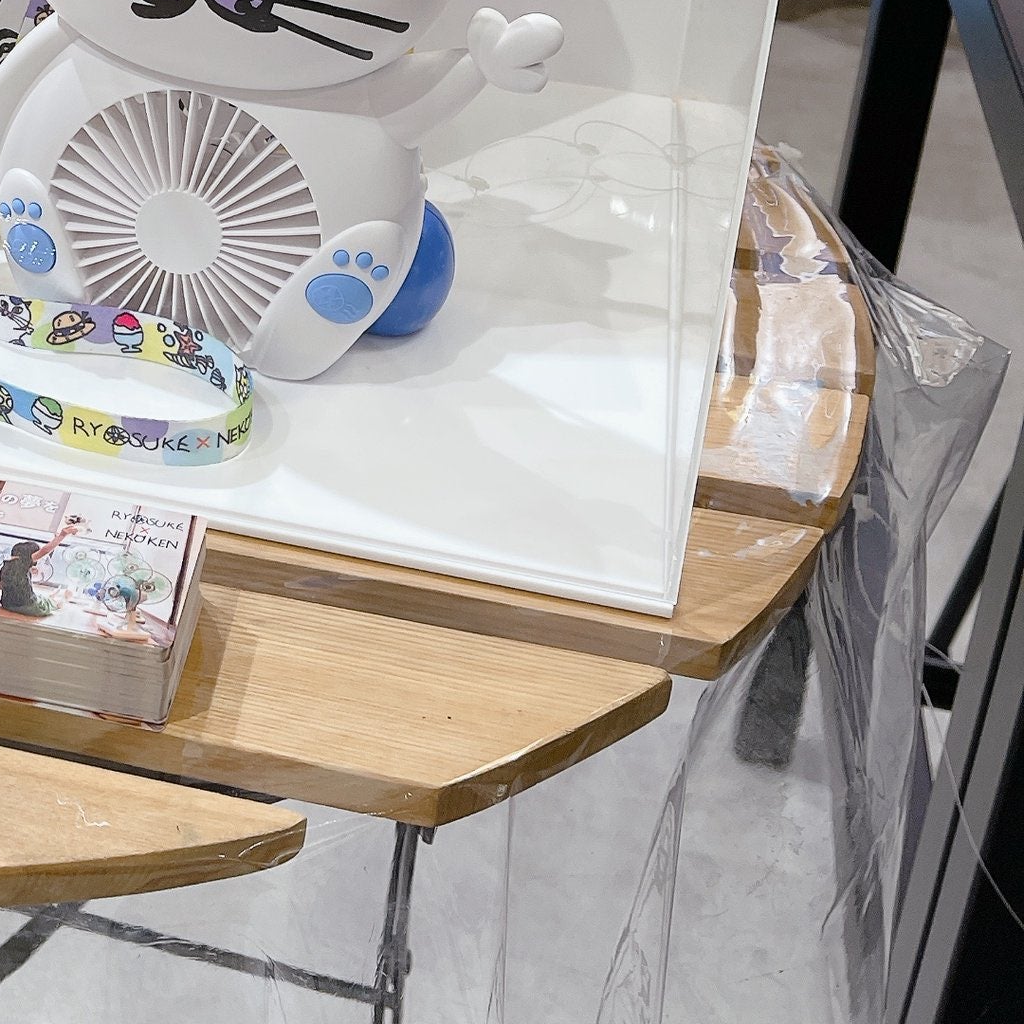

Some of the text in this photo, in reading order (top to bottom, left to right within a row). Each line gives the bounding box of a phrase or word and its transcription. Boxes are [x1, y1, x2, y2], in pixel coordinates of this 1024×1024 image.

[73, 416, 190, 452] RYOSUKE
[111, 510, 184, 532] RYOSUKE
[104, 529, 179, 549] NEKOKEN
